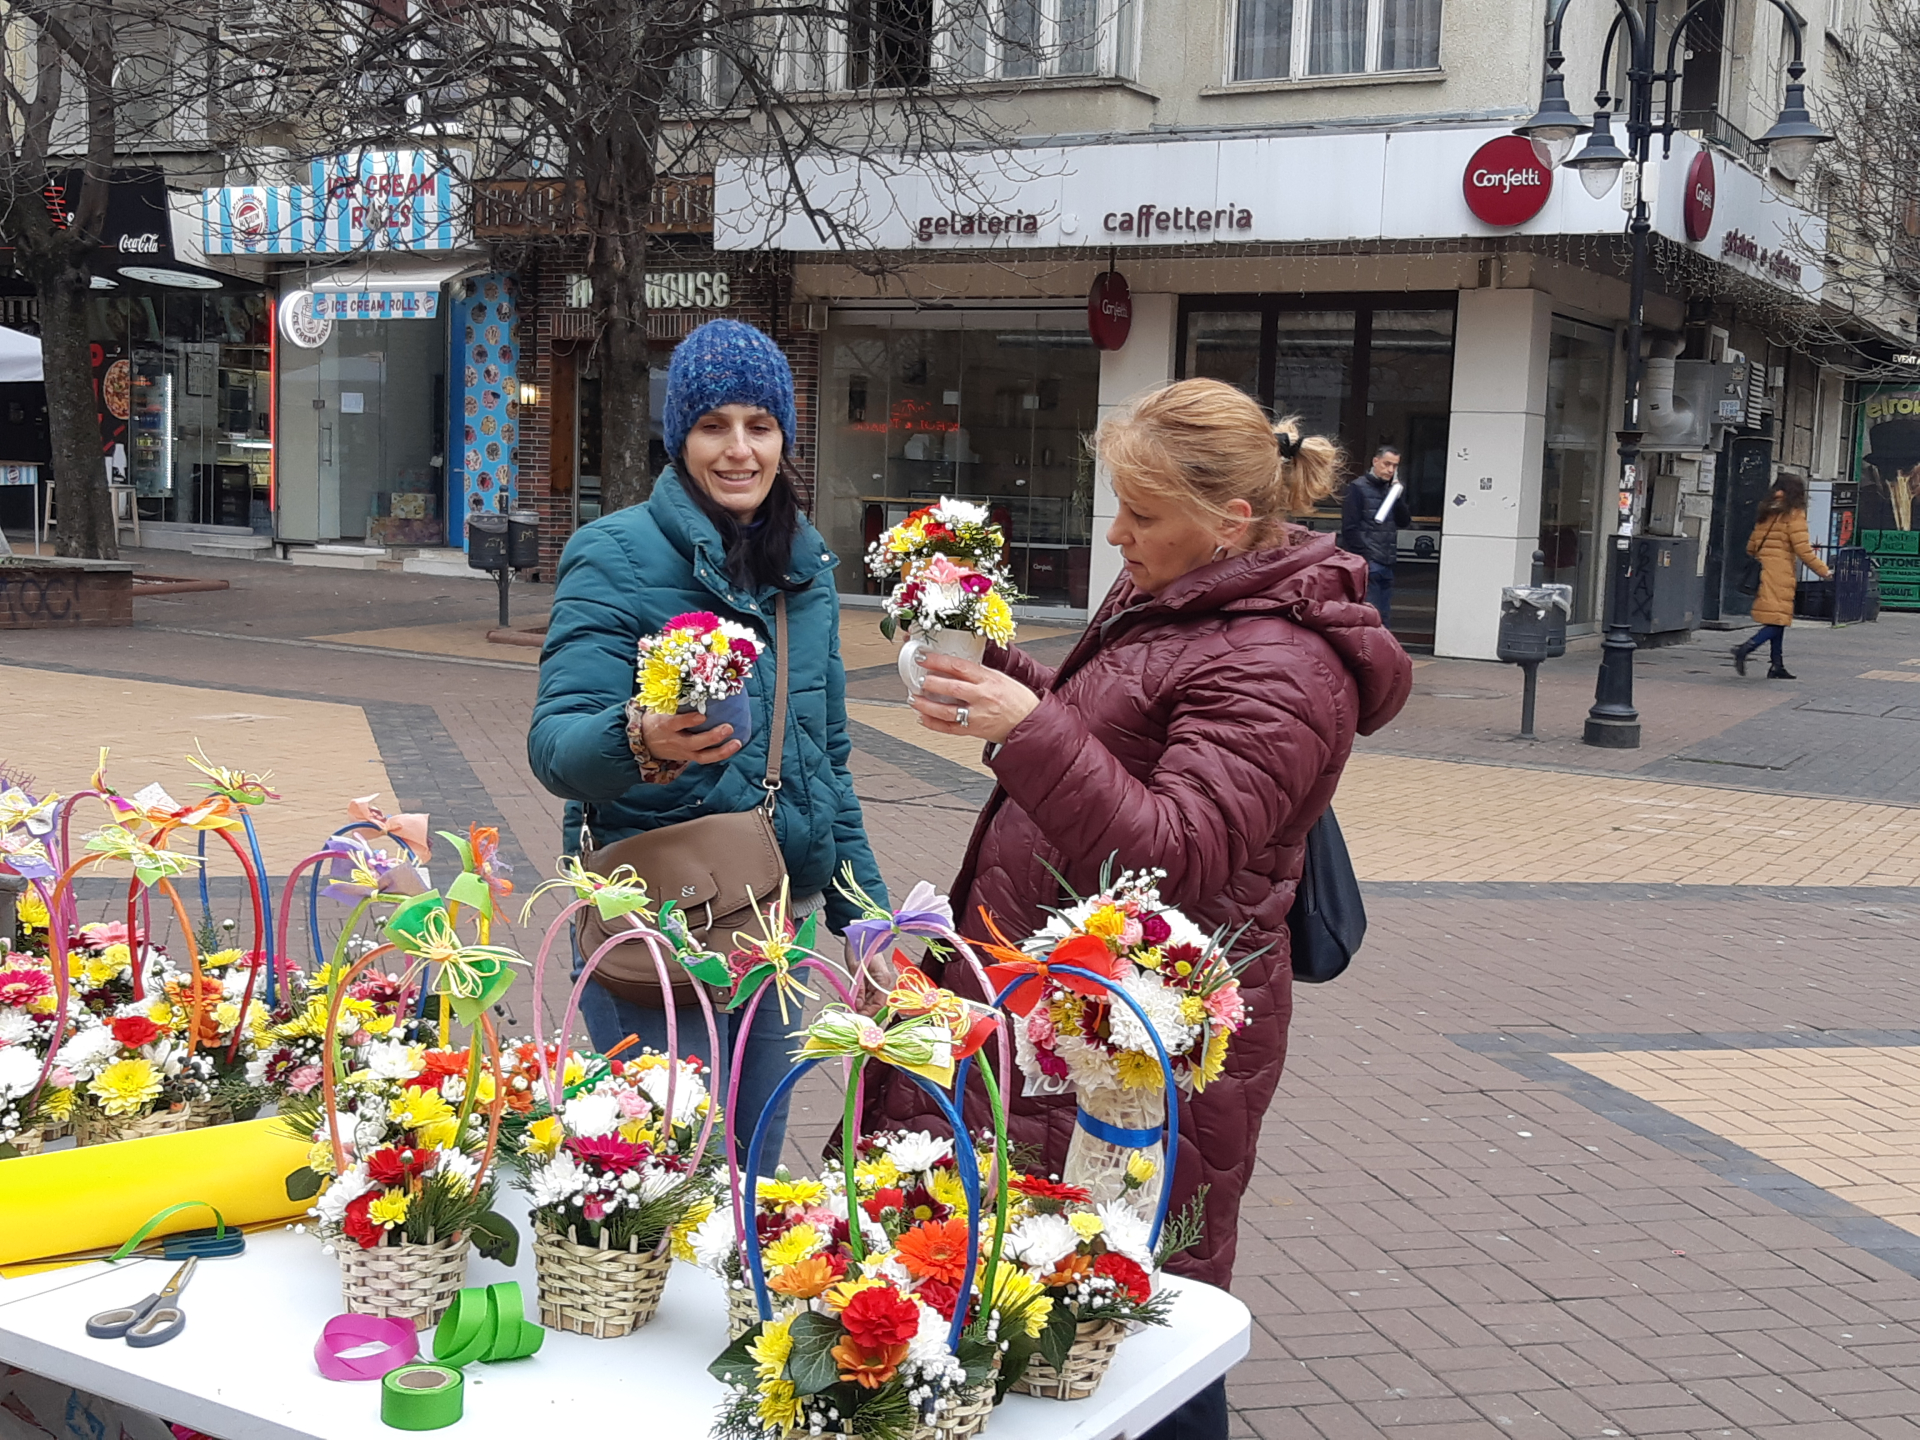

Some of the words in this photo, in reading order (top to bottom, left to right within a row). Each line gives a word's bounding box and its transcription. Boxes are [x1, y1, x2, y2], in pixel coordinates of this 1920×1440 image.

[327, 177, 357, 199] ICE
[365, 173, 436, 198] CREAM
[1473, 168, 1541, 194] Confetti
[351, 204, 411, 230] RLS
[917, 208, 1039, 242] gelateria
[1102, 202, 1253, 238] caffetteria
[331, 300, 347, 313] ICE
[350, 299, 385, 313] CREAM
[389, 298, 420, 311] ROLLS
[295, 327, 317, 344] CREAM
[1892, 353, 1917, 365] EVENT
